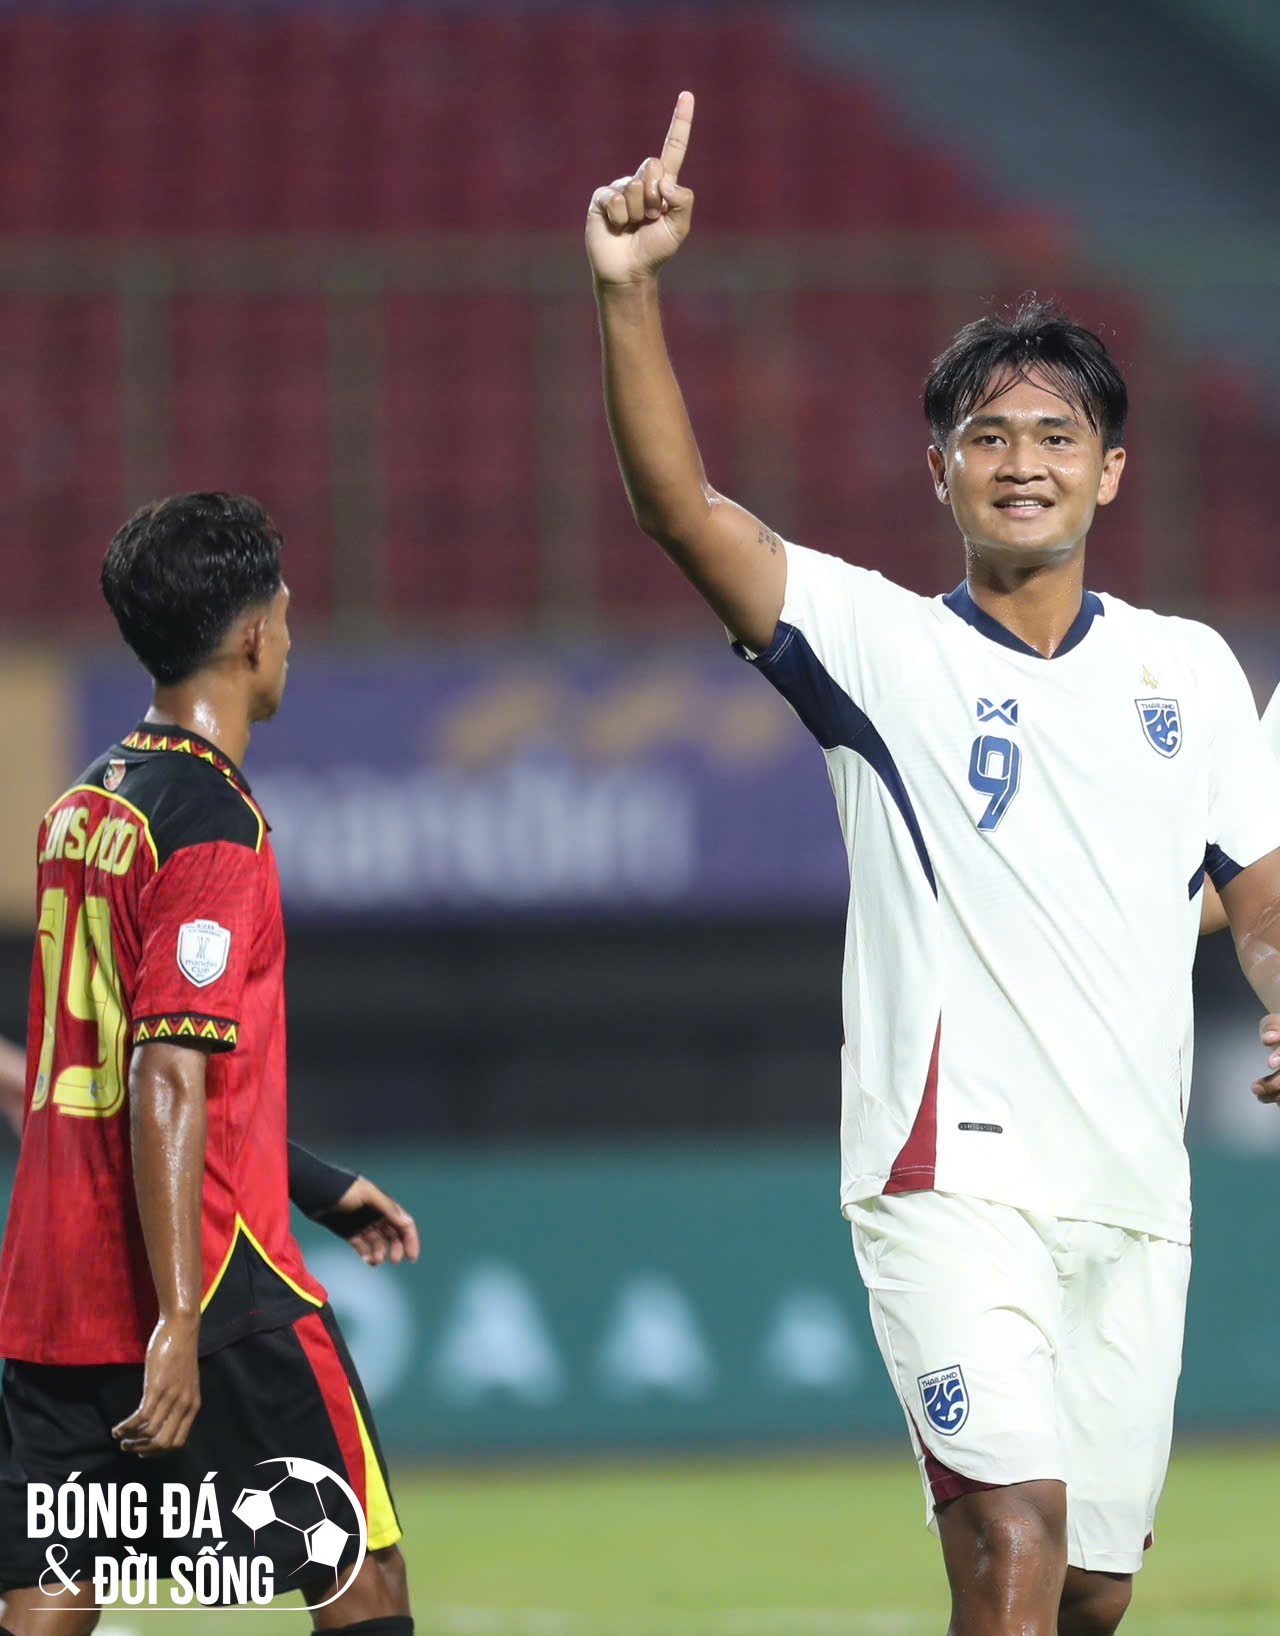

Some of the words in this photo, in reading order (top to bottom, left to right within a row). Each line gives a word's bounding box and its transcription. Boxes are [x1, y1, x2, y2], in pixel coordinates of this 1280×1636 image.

[968, 735, 1022, 833] 9
[31, 887, 127, 1119] 19
[921, 1371, 958, 1388] THAILAND
